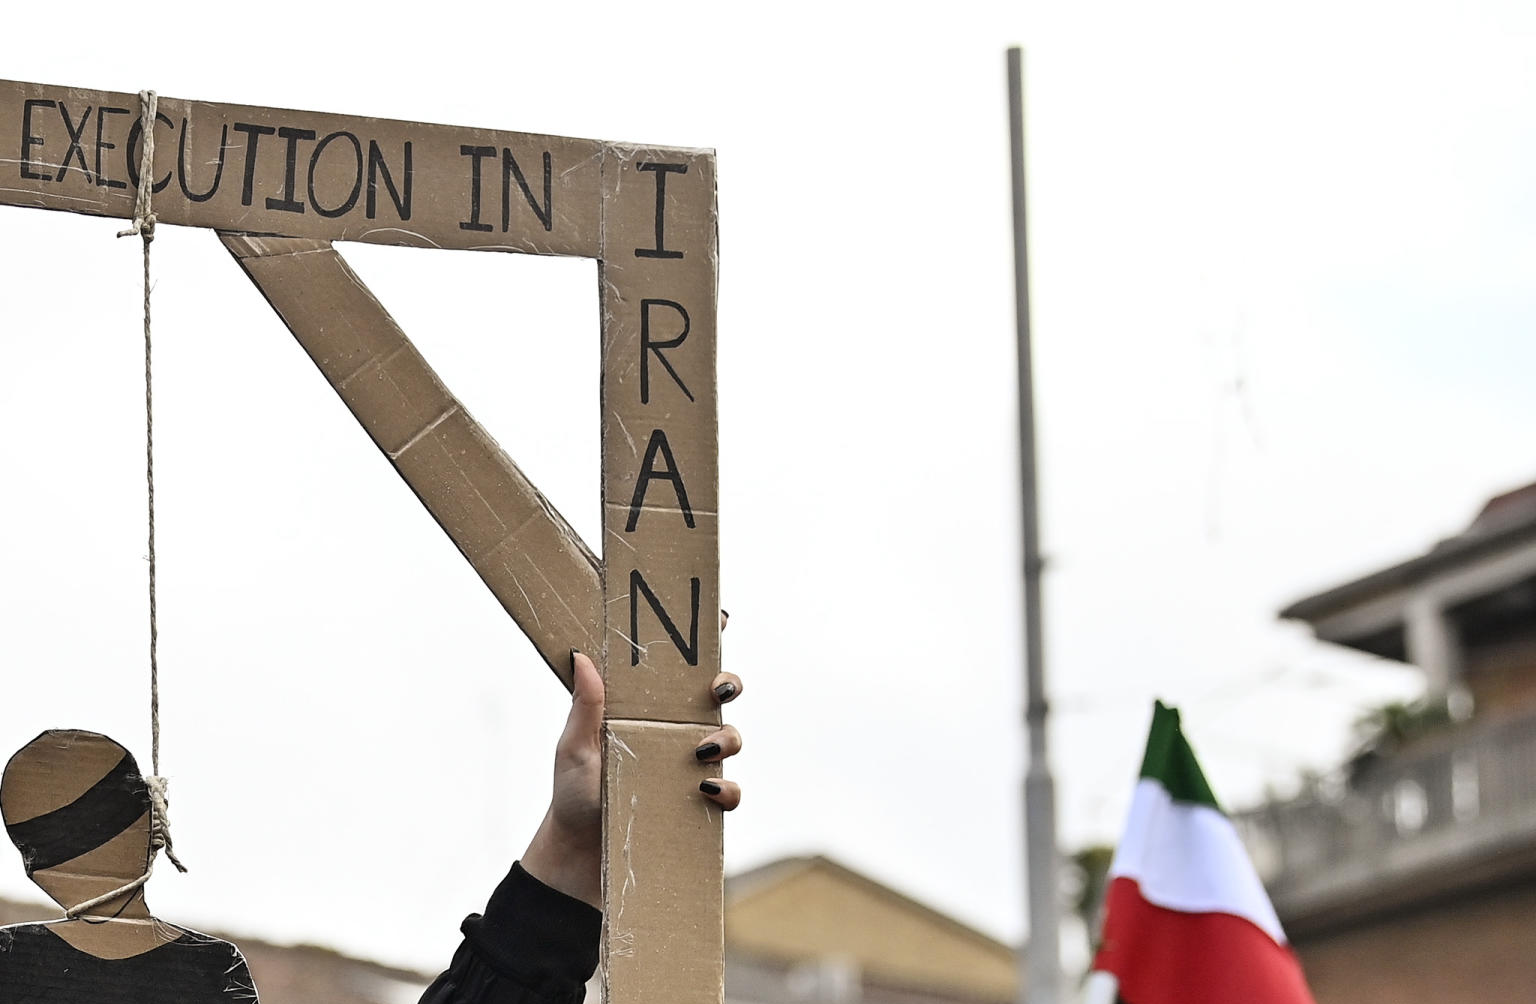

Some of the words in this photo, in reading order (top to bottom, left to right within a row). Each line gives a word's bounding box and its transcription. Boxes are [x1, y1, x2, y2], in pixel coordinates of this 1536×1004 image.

[21, 97, 413, 222] EXECUTION
[458, 144, 555, 233] IN
[624, 160, 703, 668] IRAN
